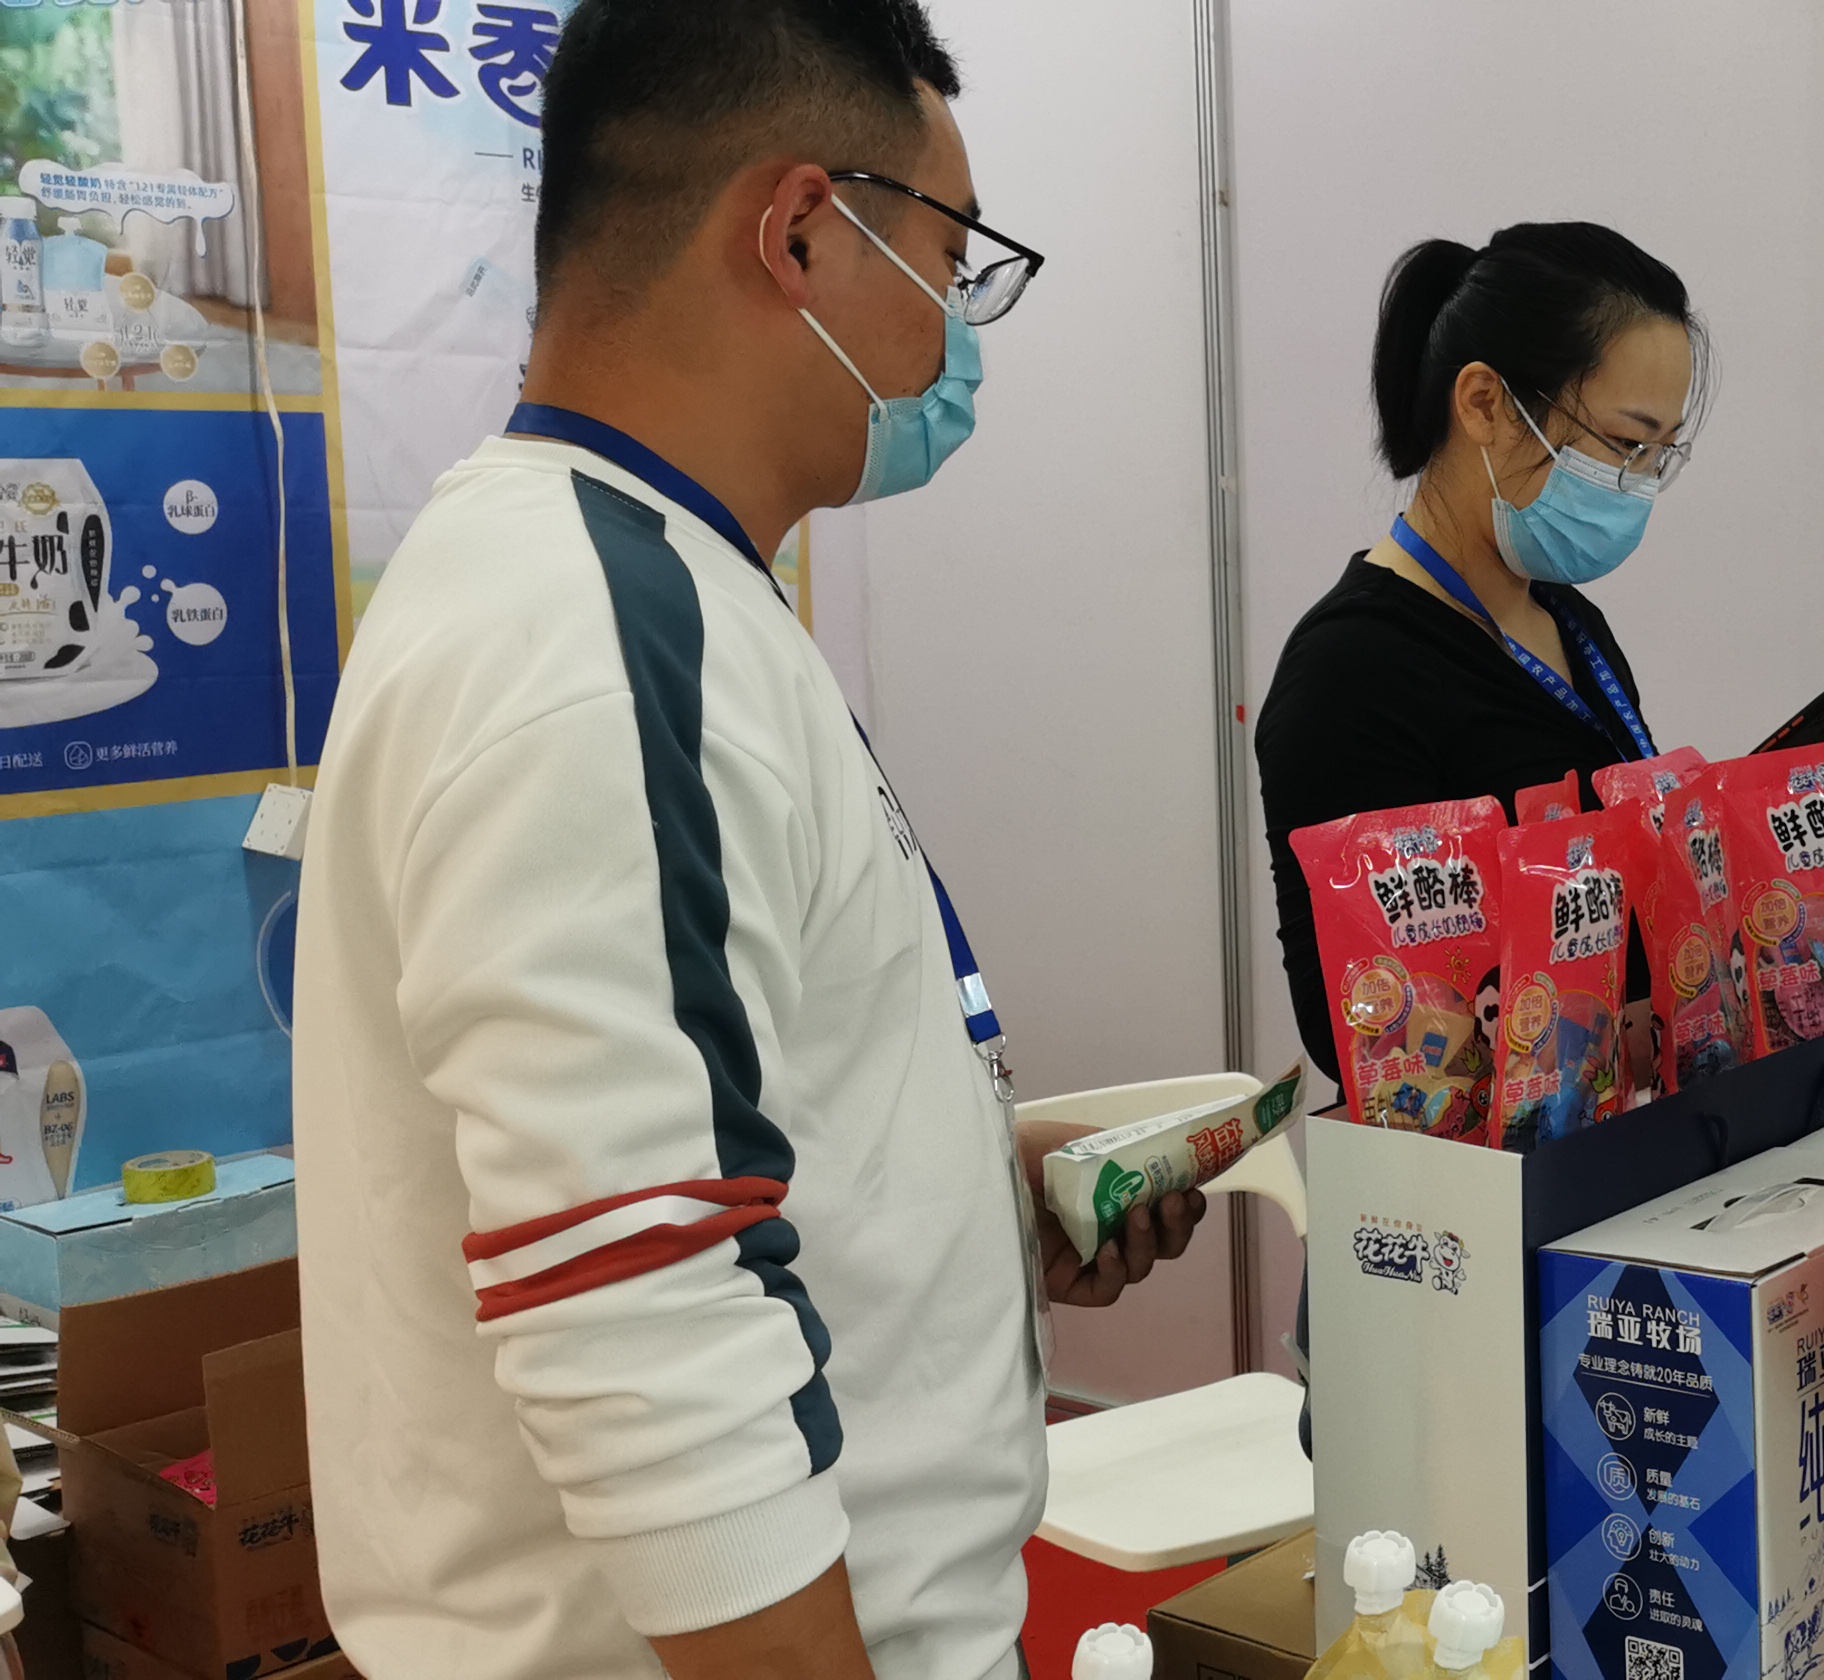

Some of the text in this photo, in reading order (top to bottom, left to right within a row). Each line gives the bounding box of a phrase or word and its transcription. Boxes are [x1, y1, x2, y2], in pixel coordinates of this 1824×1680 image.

[167, 504, 216, 519] 乳球蛋白
[171, 608, 224, 624] 乳铁蛋白
[96, 740, 179, 763] 更多鲜活营养
[1373, 863, 1480, 925] 鲜酪棒
[1760, 898, 1787, 913] 加倍
[1554, 873, 1624, 940] 鲜酪棒
[1361, 978, 1392, 997] 加倍
[1758, 961, 1820, 990] 草莓味
[1519, 994, 1544, 1012] 加倍
[1519, 1014, 1543, 1034] 营养
[1674, 1011, 1726, 1045] 草莓味
[1356, 1052, 1427, 1087] 草莓味
[46, 1091, 75, 1105] LABS
[1504, 1069, 1562, 1105] 草莓味
[44, 1121, 73, 1136] BZ-06
[1354, 1228, 1431, 1280] 花花牛
[1587, 1294, 1701, 1327] RUIYA RANCH
[1586, 1310, 1703, 1356] 瑞亚牧场
[1578, 1353, 1714, 1393] 专业理念铸就20年品质
[1643, 1406, 1671, 1427] 新鲜
[1643, 1427, 1699, 1451] 成长的主题
[1646, 1467, 1674, 1489] 质量
[1646, 1488, 1701, 1512] 发展的基石
[1648, 1527, 1676, 1549] 创新
[1648, 1548, 1700, 1572] 壮大的动力
[1648, 1588, 1676, 1609] 责任
[1649, 1607, 1704, 1633] 进取的灵魂
